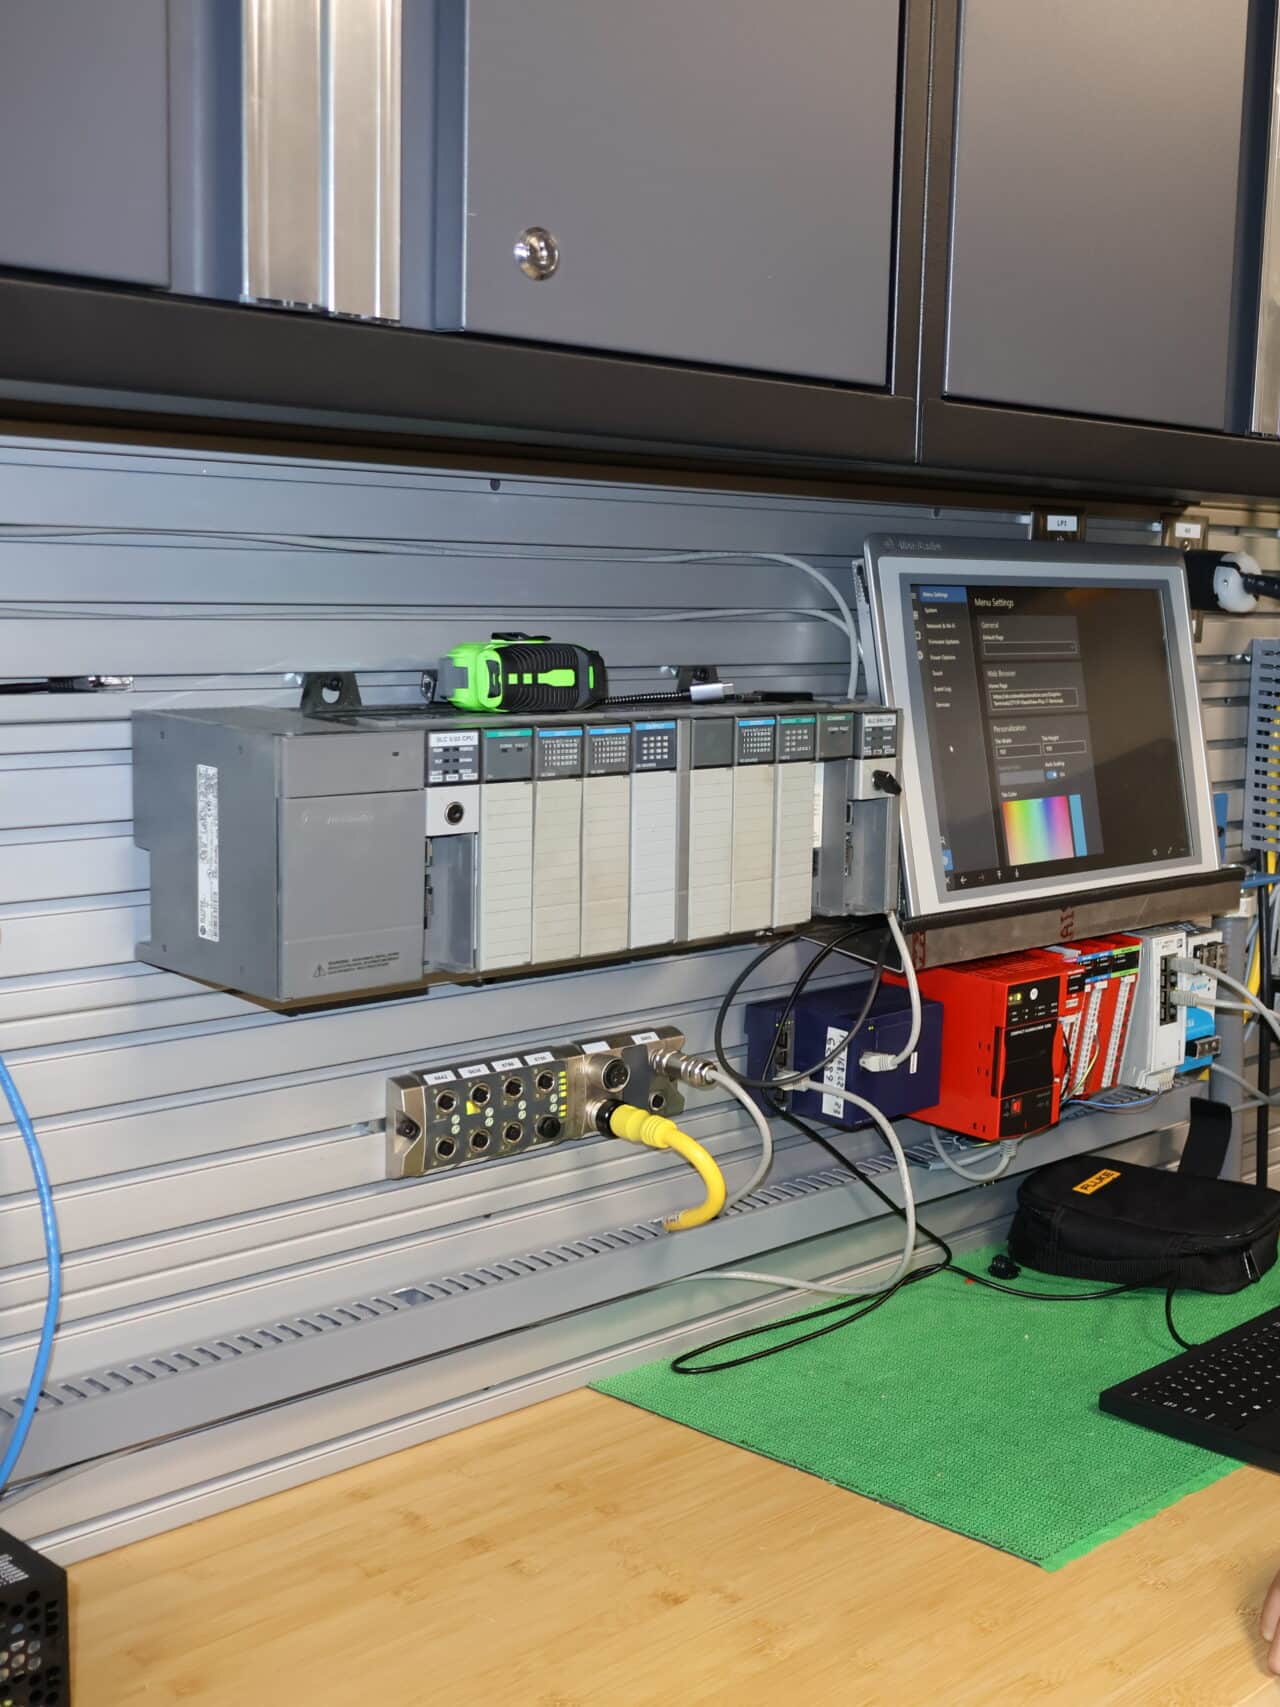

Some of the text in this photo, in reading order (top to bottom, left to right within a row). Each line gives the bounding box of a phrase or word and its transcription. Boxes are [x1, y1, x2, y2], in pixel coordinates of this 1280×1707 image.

[974, 598, 1015, 609] Menu Settings
[1080, 1171, 1114, 1190] FLUKE
